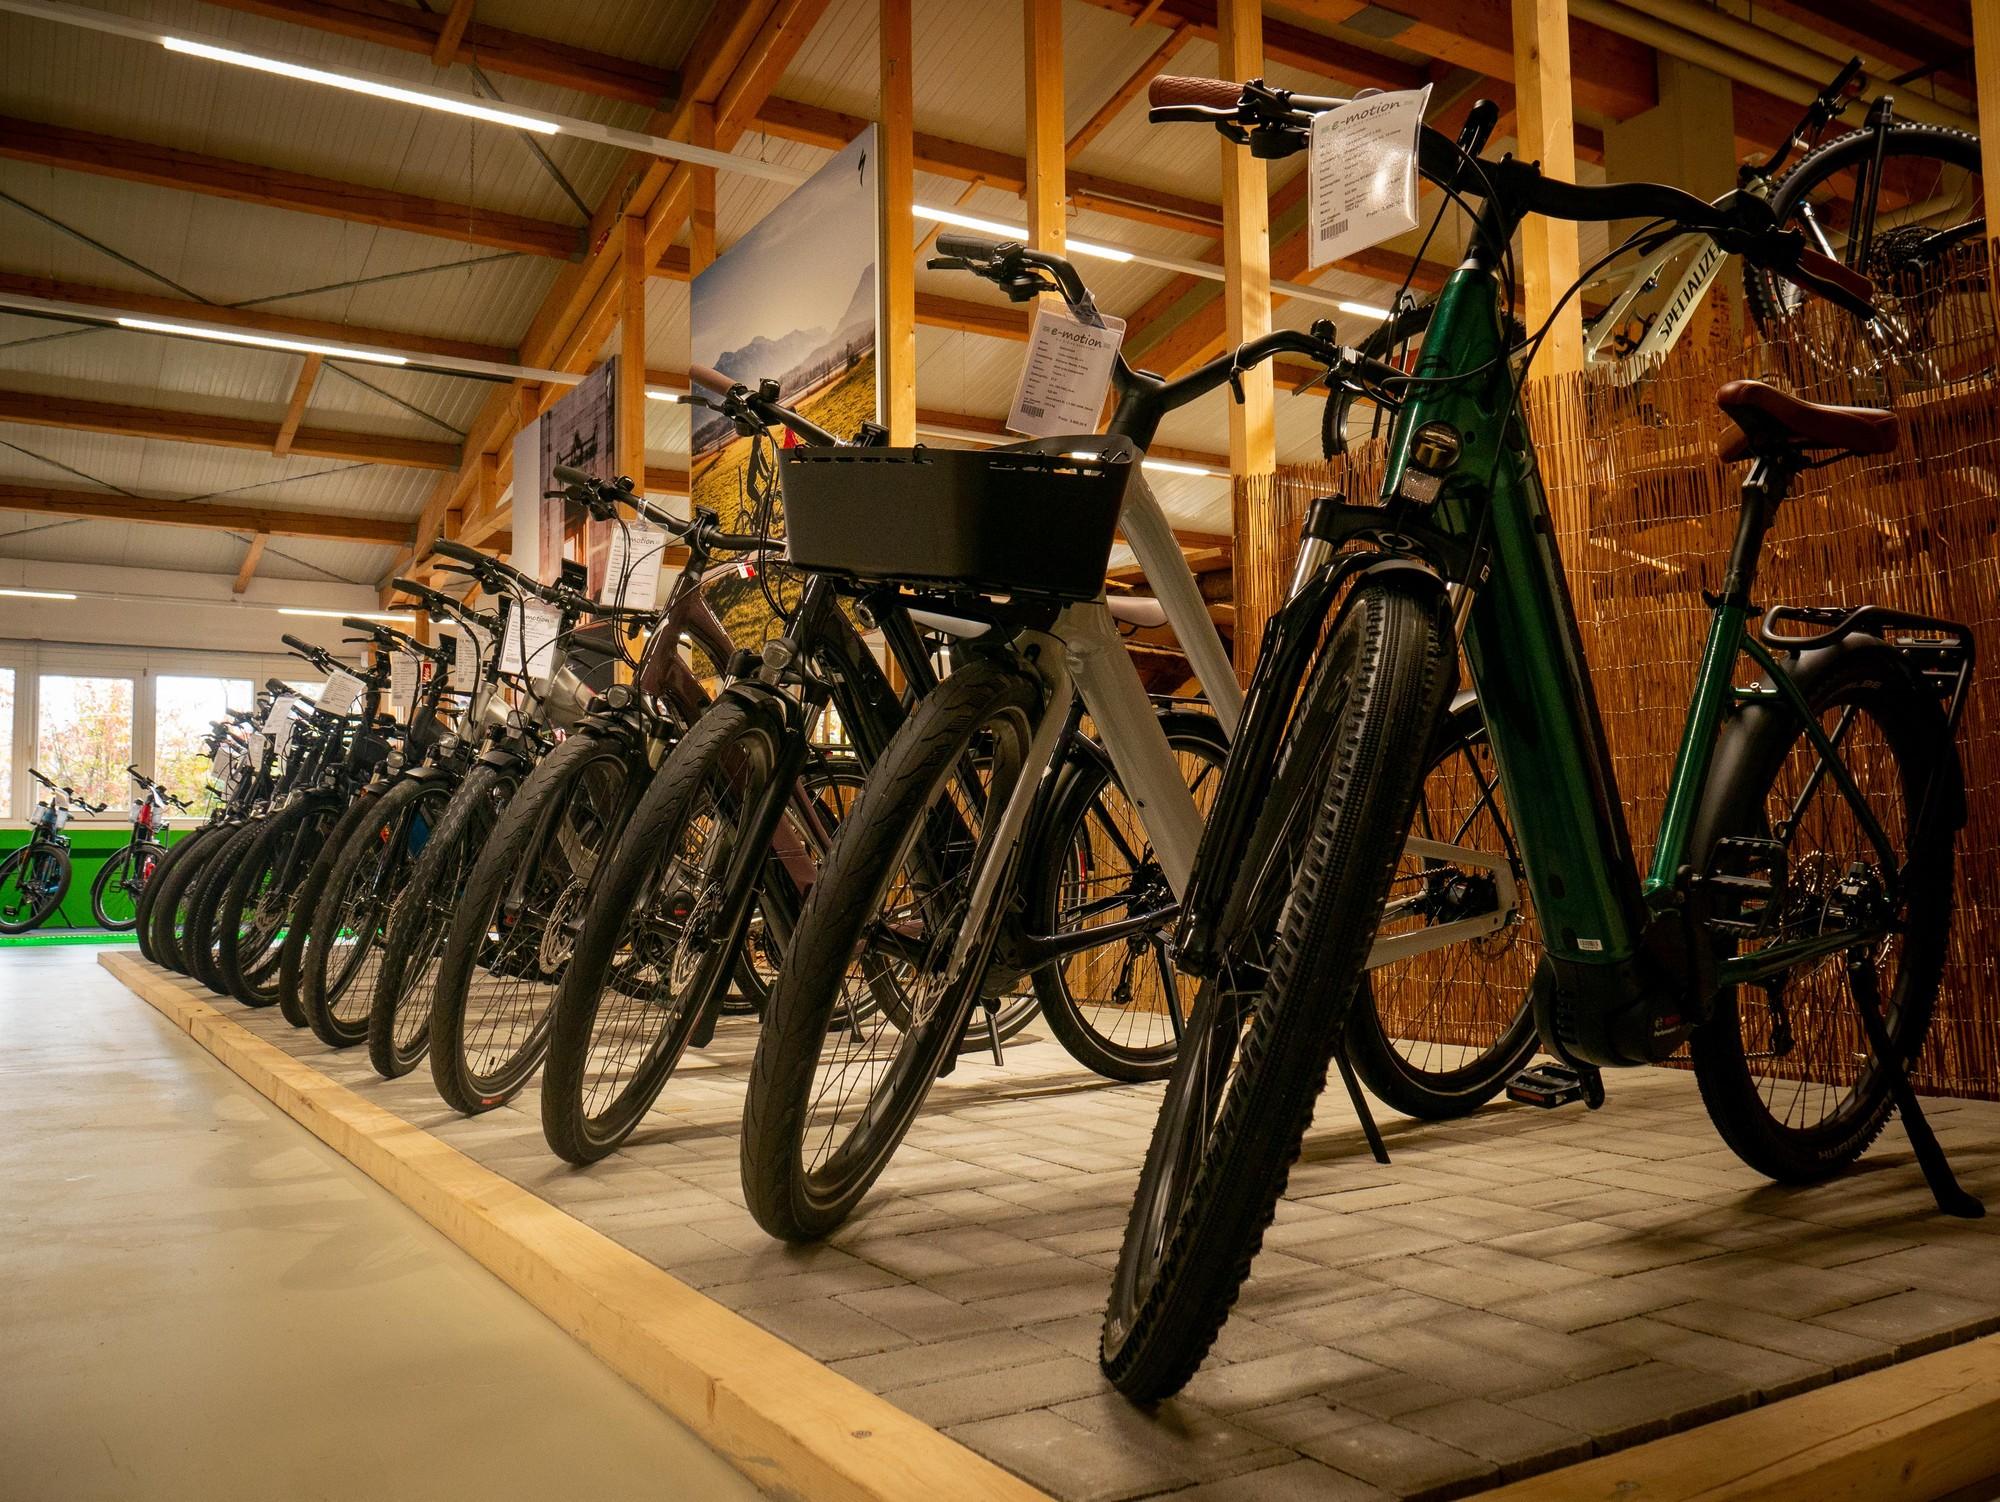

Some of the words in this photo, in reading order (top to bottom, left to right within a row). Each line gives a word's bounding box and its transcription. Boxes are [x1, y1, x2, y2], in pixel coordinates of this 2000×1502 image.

[1331, 100, 1400, 131] e-motion
[1658, 243, 1722, 342] SPECIALIZE
[1051, 327, 1102, 348] e-motion
